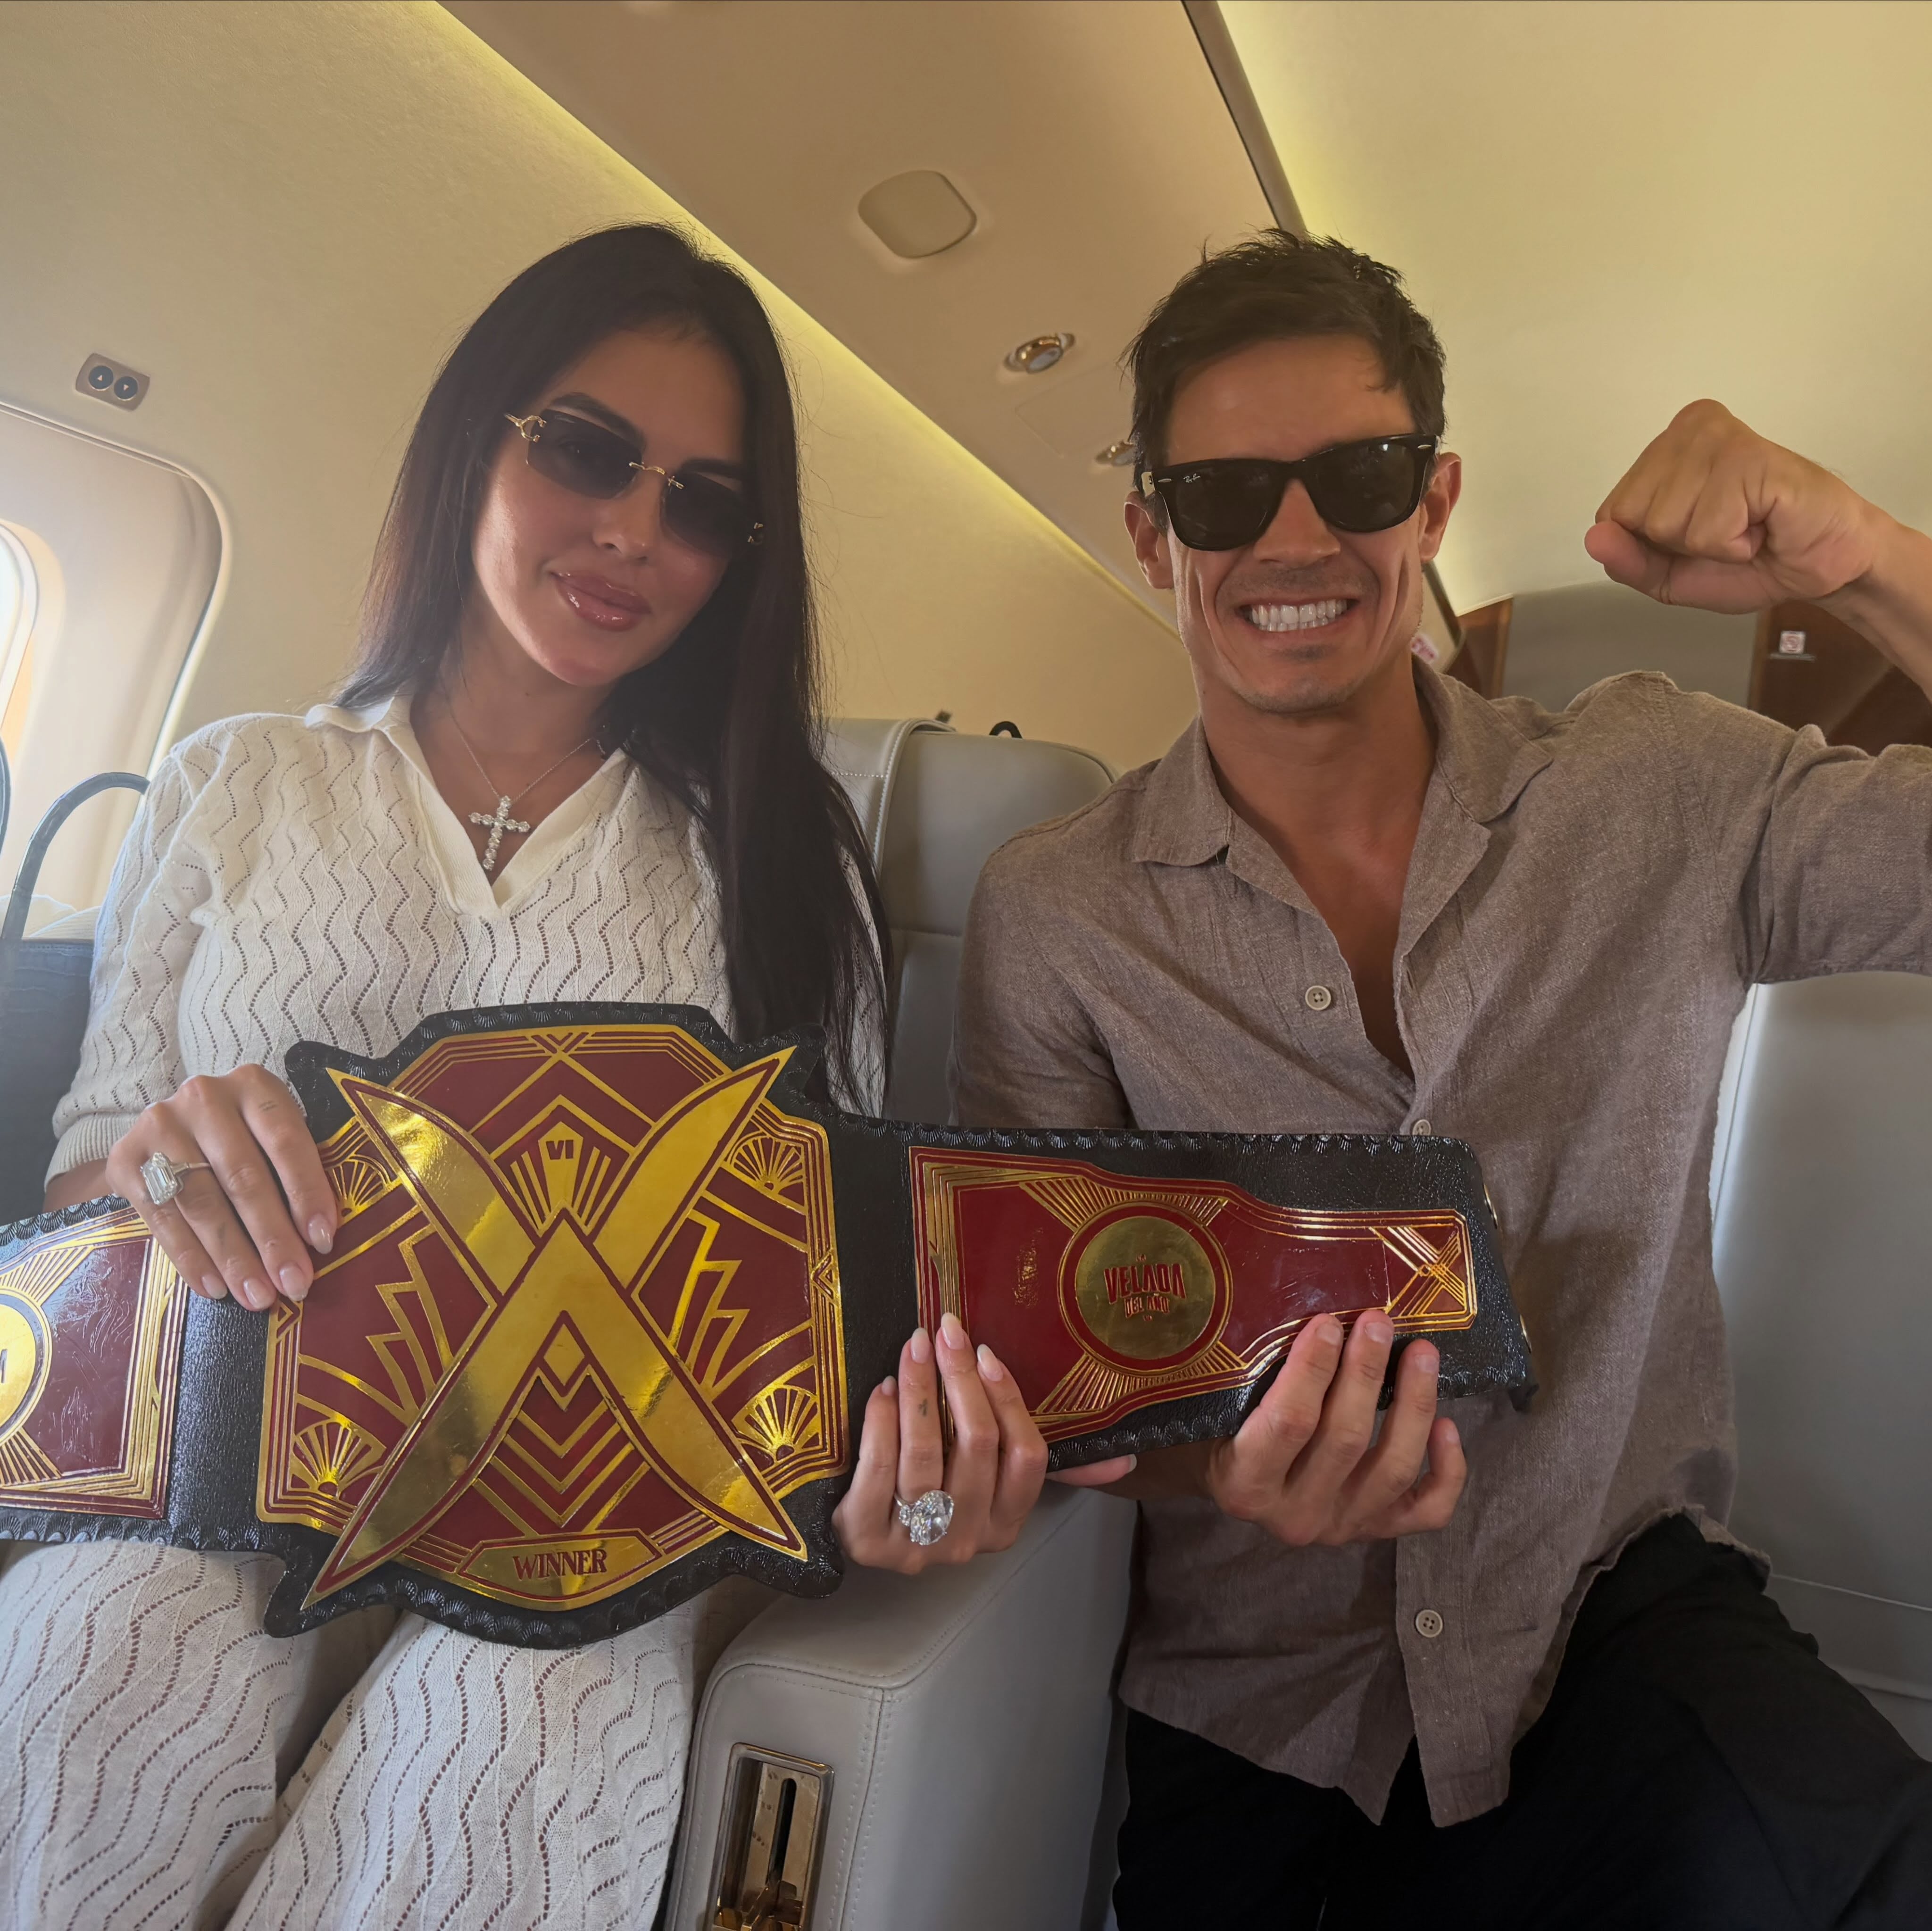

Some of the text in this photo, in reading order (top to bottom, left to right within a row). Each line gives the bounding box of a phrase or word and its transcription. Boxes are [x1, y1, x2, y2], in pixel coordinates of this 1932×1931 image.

[546, 1140, 574, 1160] VI
[1104, 1264, 1186, 1304] VELADA
[1124, 1297, 1144, 1318] DEL
[513, 1549, 607, 1580] WINNER
